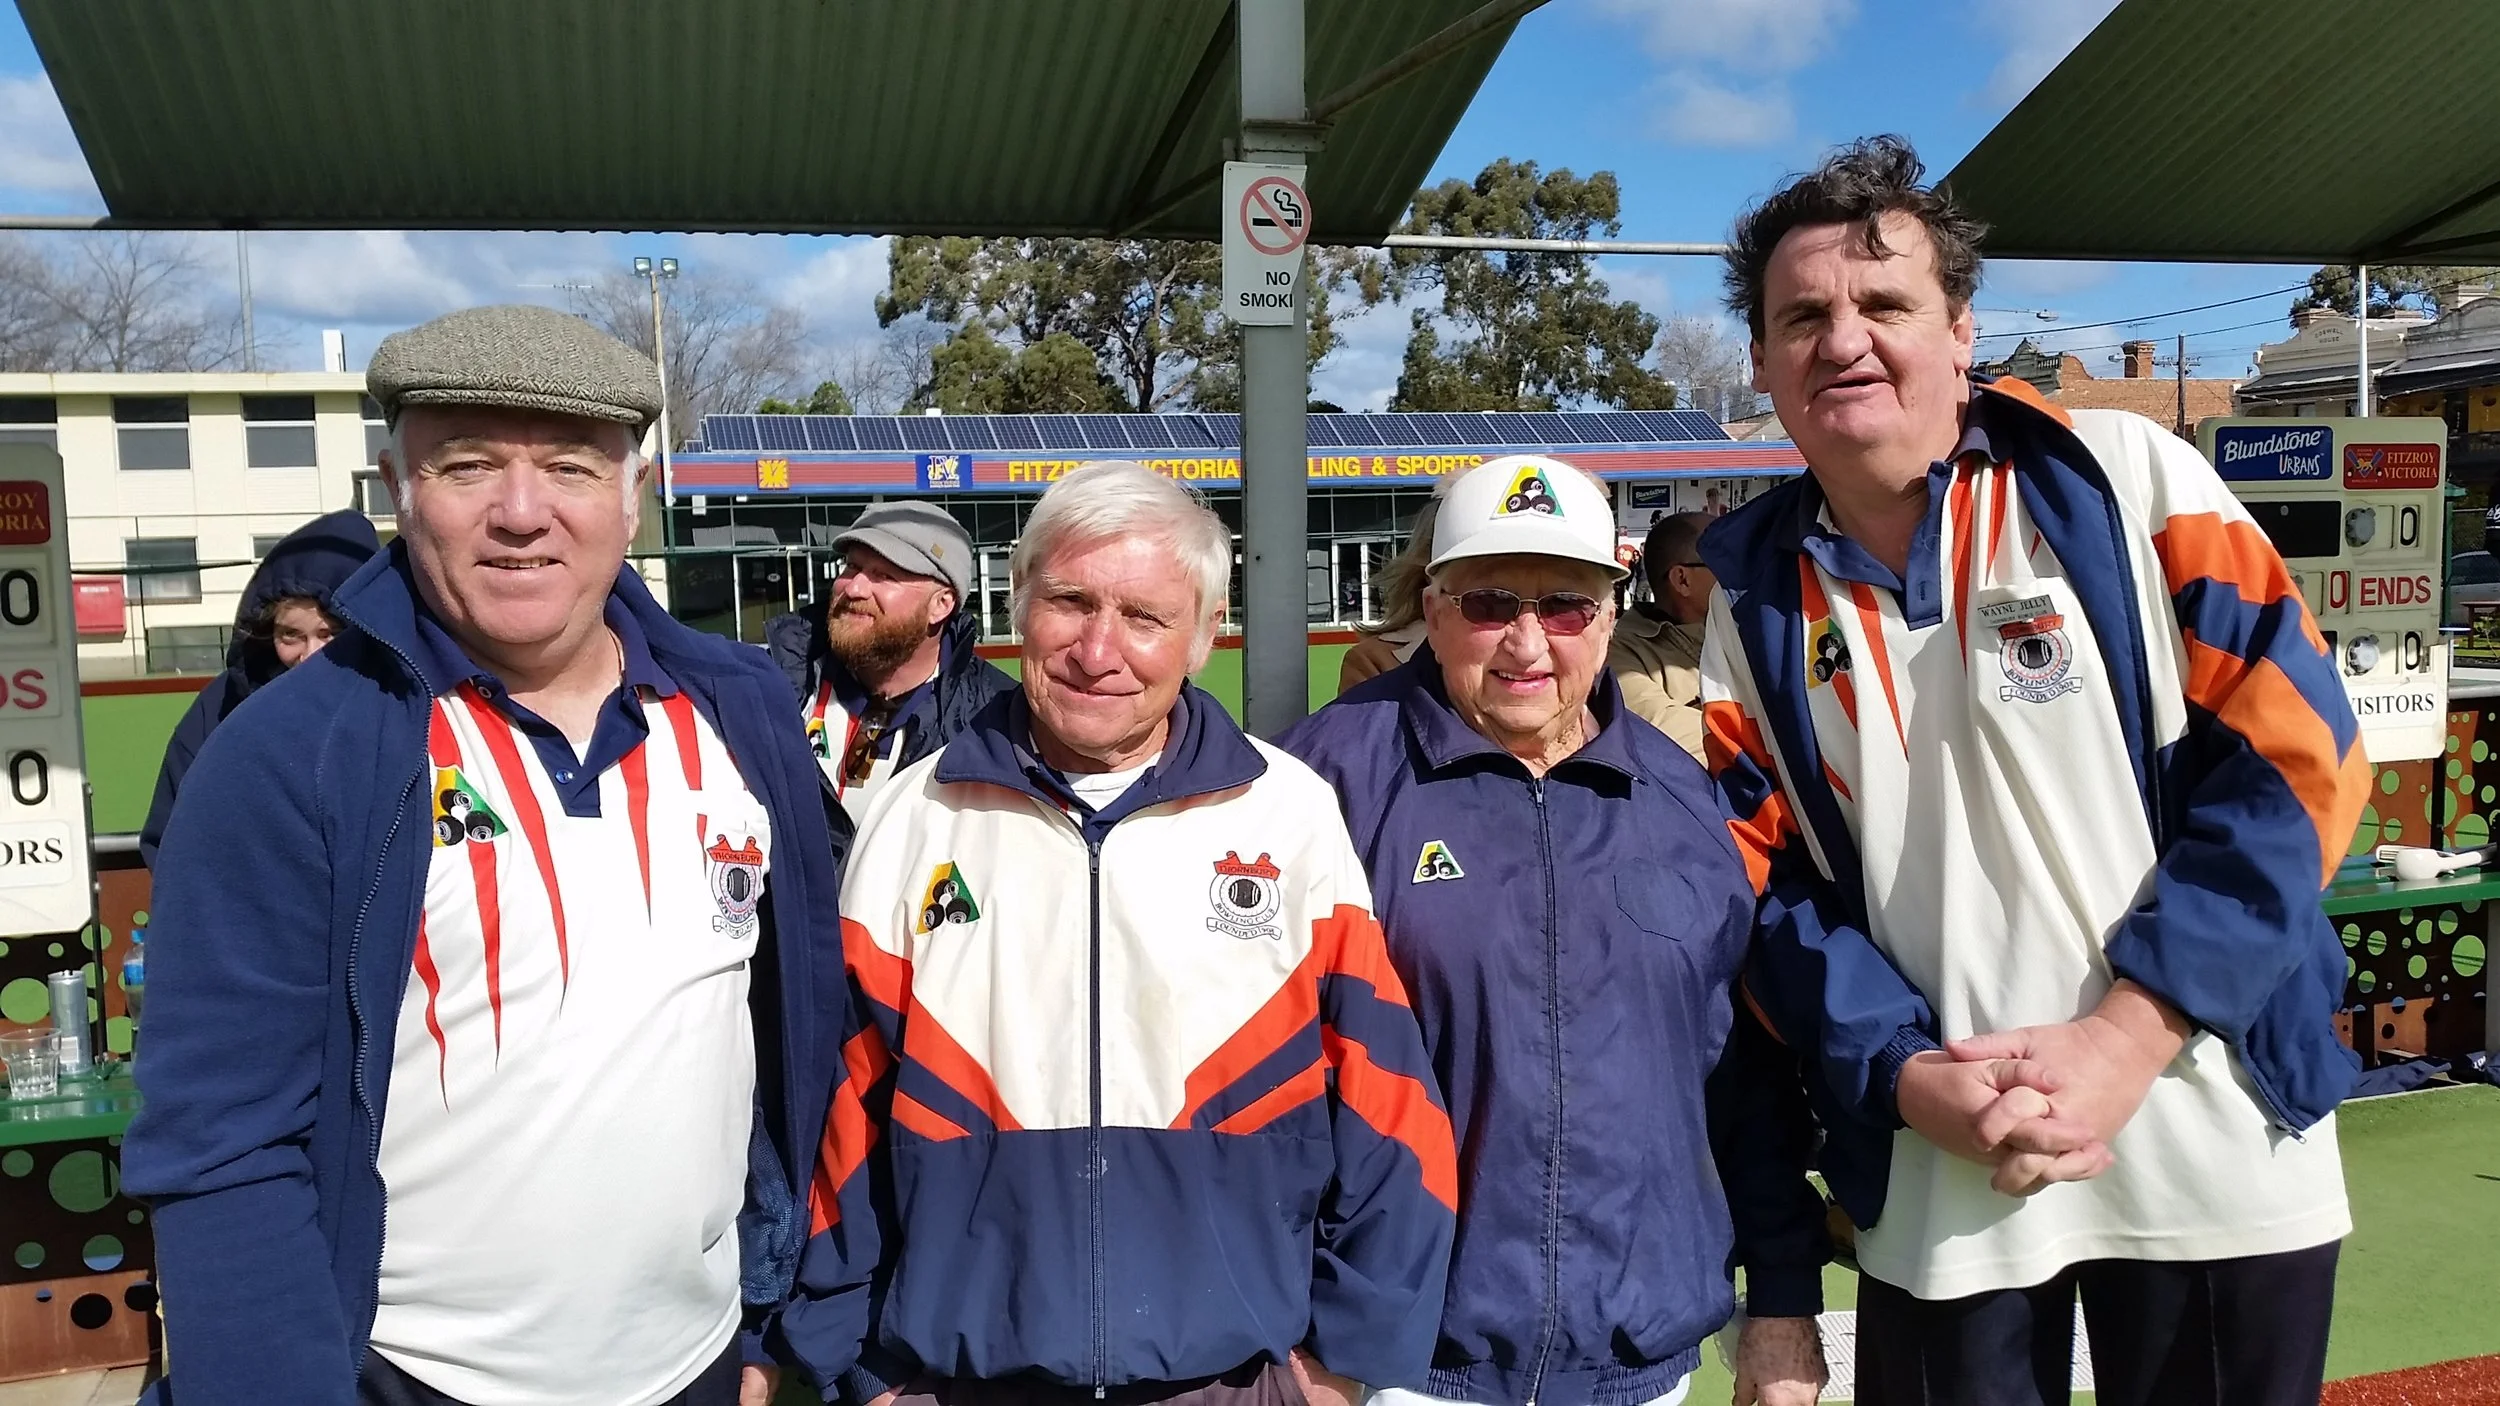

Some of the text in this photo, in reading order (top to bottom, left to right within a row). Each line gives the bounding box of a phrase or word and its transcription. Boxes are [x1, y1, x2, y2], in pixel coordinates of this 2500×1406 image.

[1266, 271, 1291, 286] NO
[1240, 292, 1293, 308] SMOKI
[2223, 430, 2322, 463] Blundstone
[2387, 451, 2435, 464] FITZROY
[1009, 461, 1097, 482] FITZR
[1308, 456, 1361, 477] LING
[1371, 456, 1388, 476] &
[1396, 455, 1483, 476] SPORTS
[2384, 467, 2438, 479] VICTORIA
[0, 492, 38, 509] OY
[0, 514, 46, 530] RIA
[2400, 506, 2418, 546] 0
[0, 569, 40, 626] 0
[2329, 570, 2432, 609] 0 ENDS
[1981, 604, 2016, 617] WAYNE
[2019, 597, 2048, 611] JELLY
[2404, 631, 2421, 670] 0
[2007, 659, 2070, 686] BOWLING CLUB
[2010, 687, 2056, 701] FOUNDED
[2351, 692, 2435, 716] ISITORS
[9, 749, 49, 806] 0
[1215, 902, 1275, 925] BOWLING CLUB
